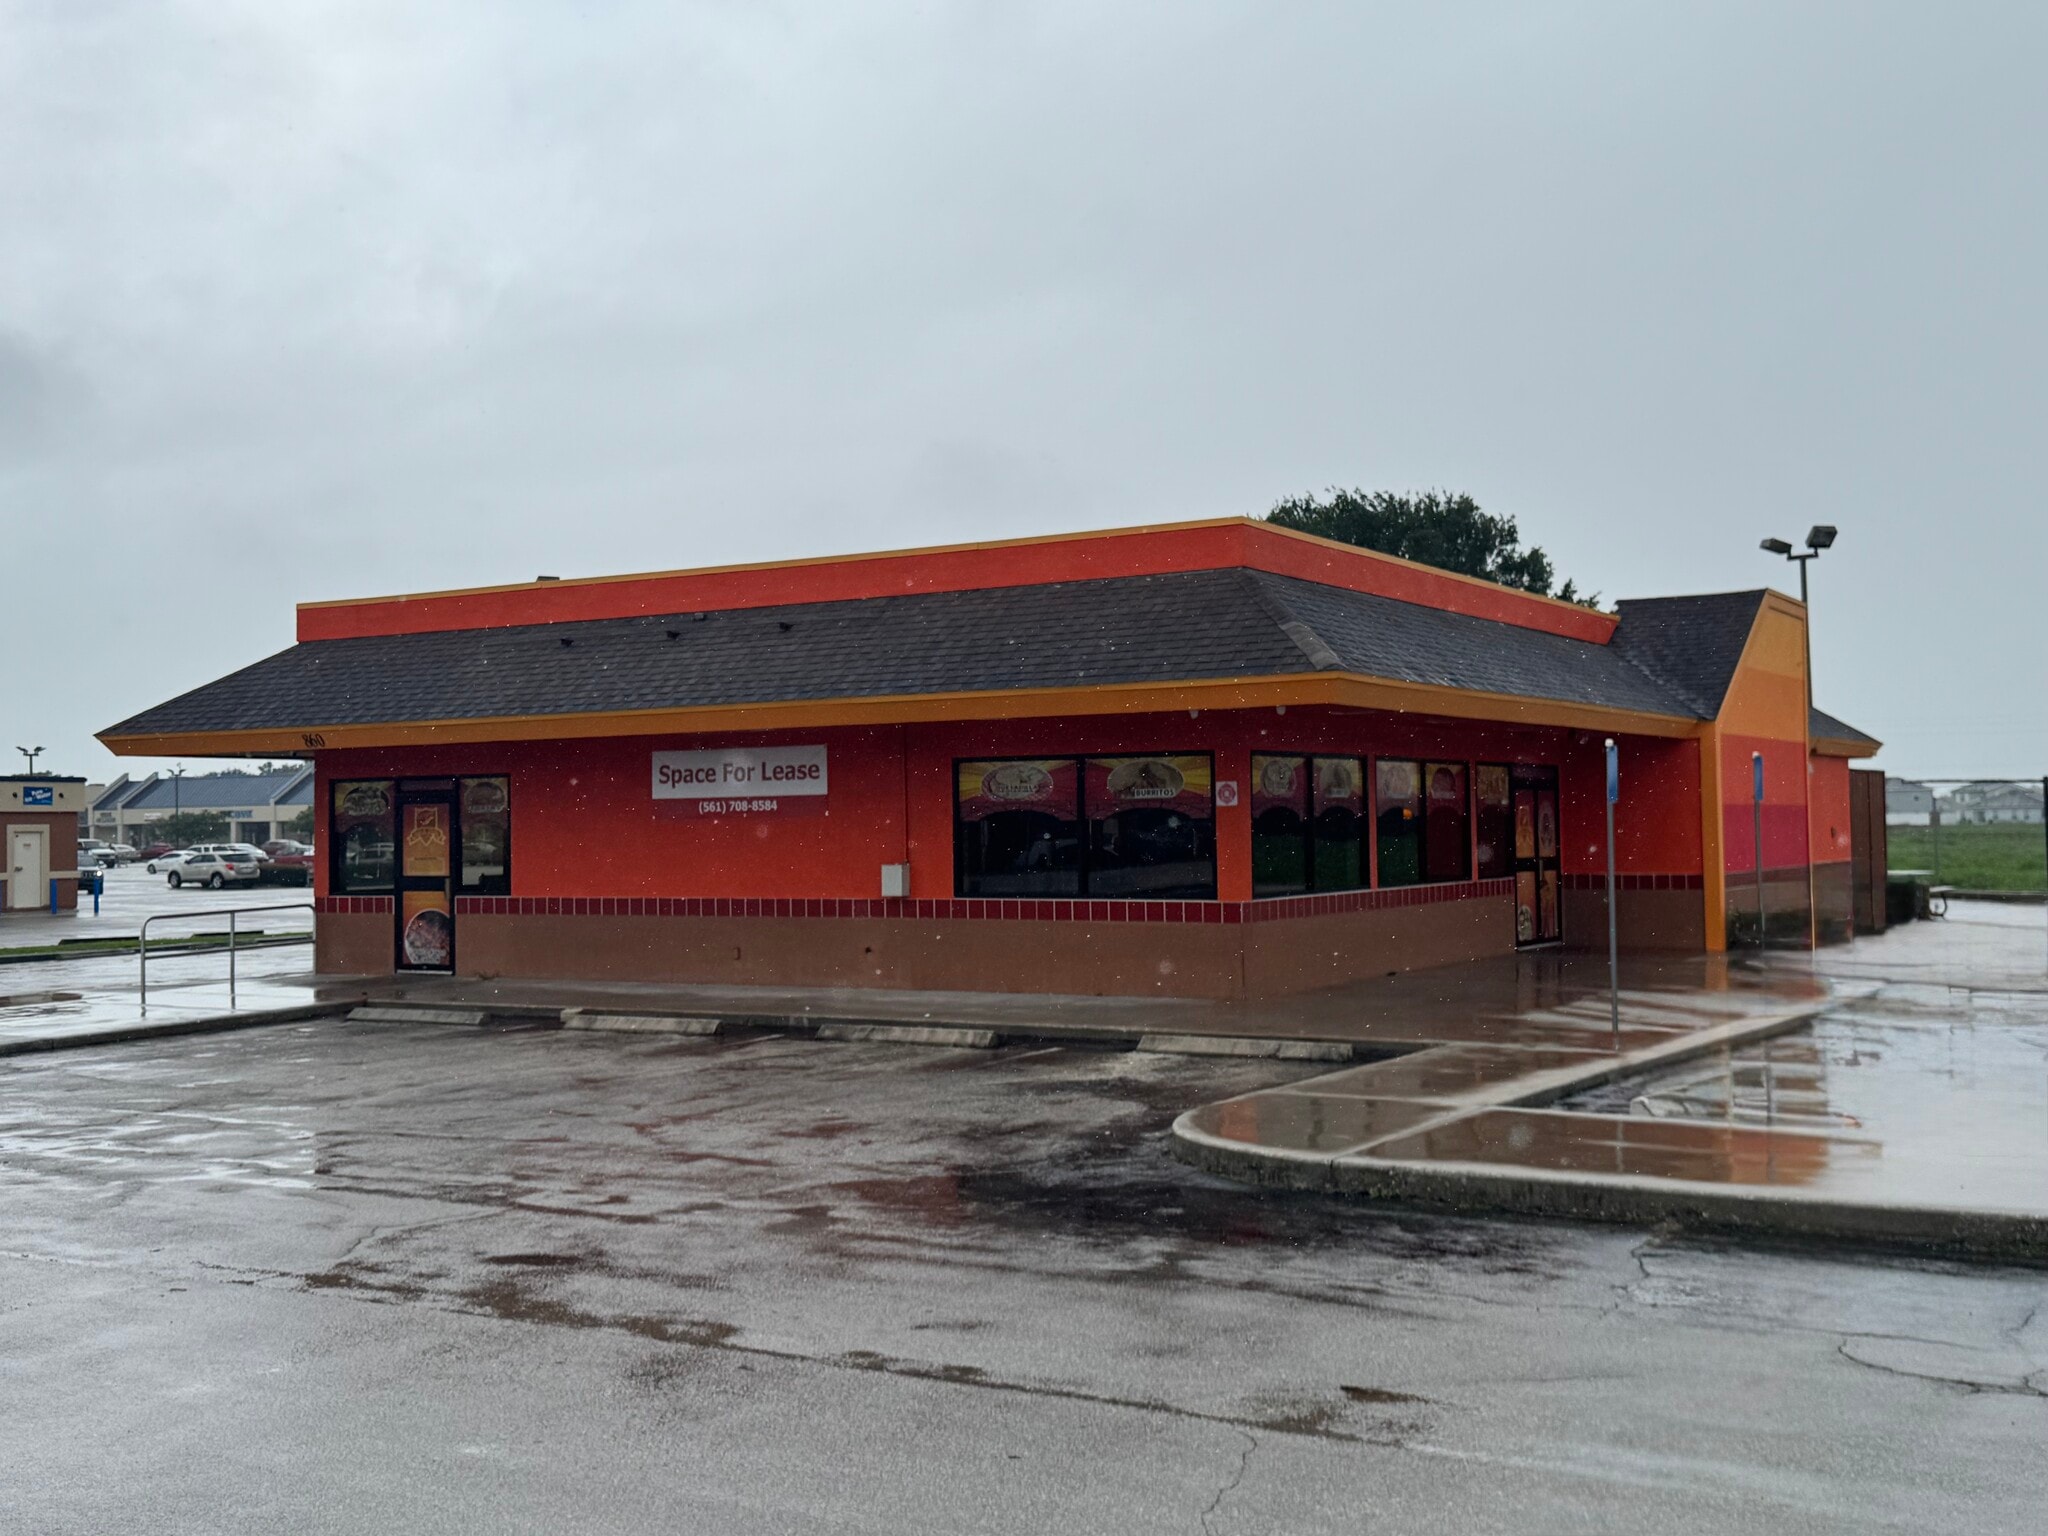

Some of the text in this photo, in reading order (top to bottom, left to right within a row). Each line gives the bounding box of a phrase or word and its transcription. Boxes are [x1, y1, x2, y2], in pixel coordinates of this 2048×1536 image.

[302, 734, 325, 748] 860
[659, 762, 820, 788] Space For Lease
[1135, 788, 1174, 797] BURRITOS
[698, 800, 777, 815] (561) 708-8584
